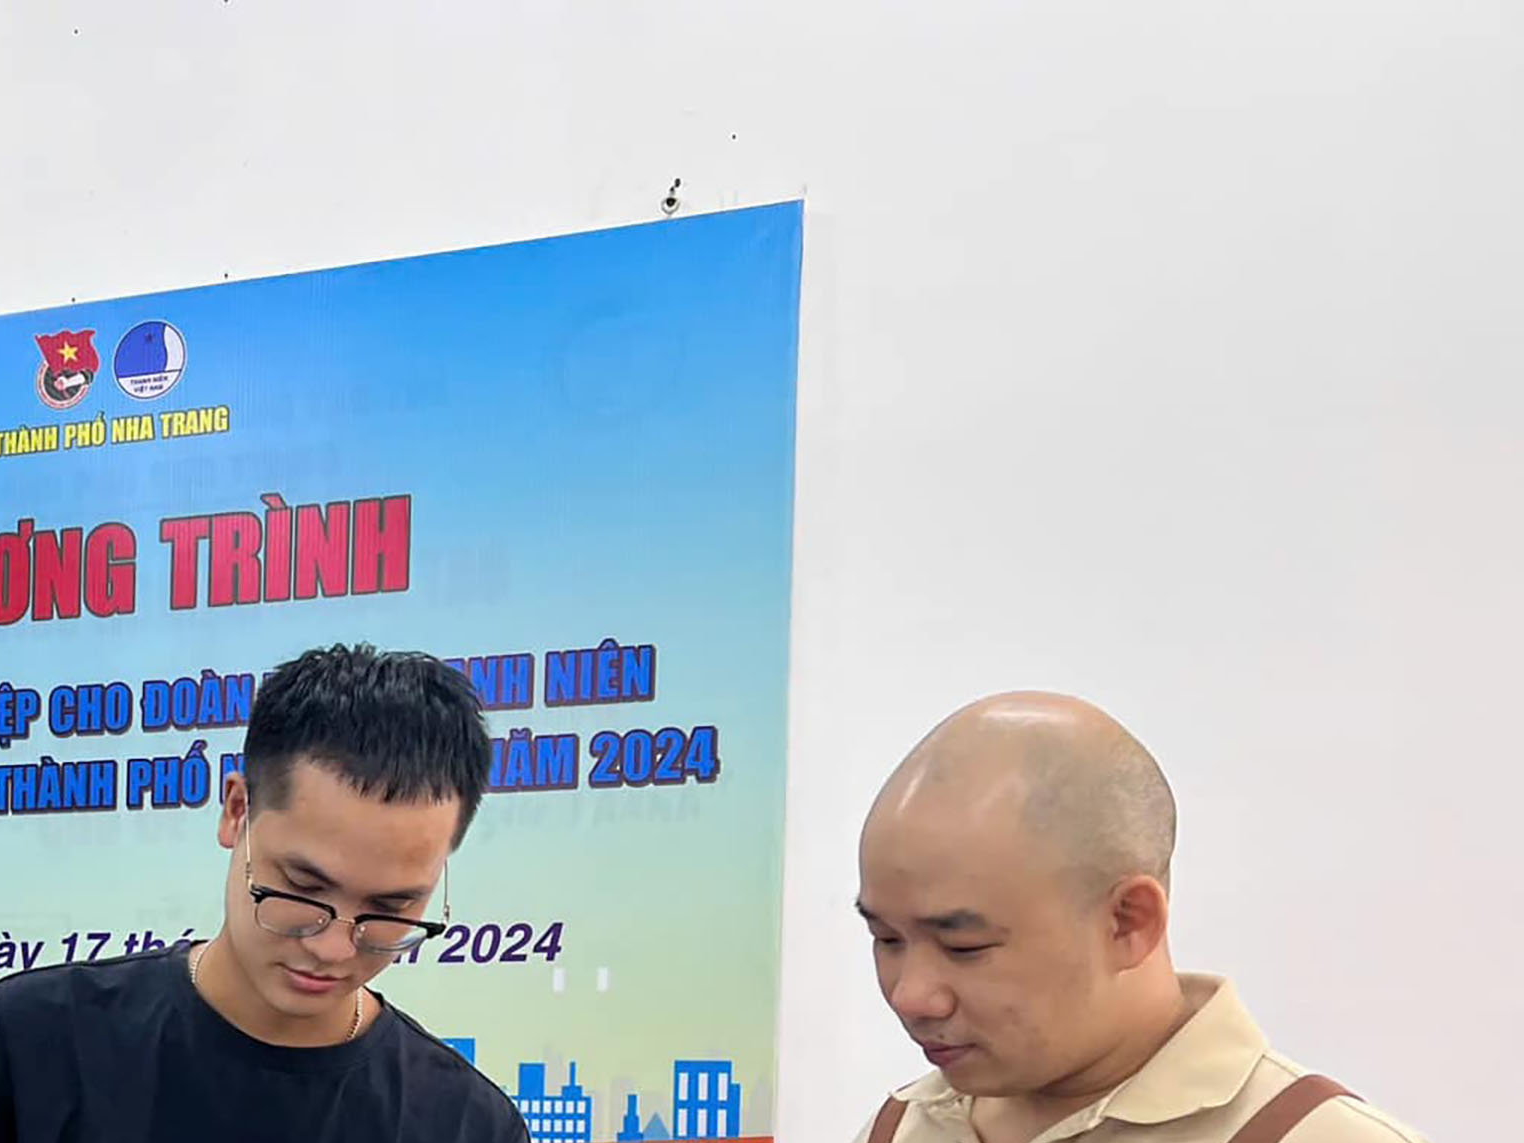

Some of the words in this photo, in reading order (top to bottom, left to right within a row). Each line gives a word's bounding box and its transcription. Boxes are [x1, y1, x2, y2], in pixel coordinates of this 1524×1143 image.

[64, 411, 107, 449] PHỐ
[111, 414, 155, 444] NHA
[161, 405, 231, 438] TRANG
[159, 492, 412, 611] TRÌNH
[48, 682, 133, 737] CHO
[141, 668, 256, 733] ĐOÀN
[544, 638, 656, 708] NIÊN
[126, 740, 211, 810] PHỐ
[588, 726, 721, 789] 2024
[61, 931, 112, 963] 17
[438, 922, 564, 964] 2024
